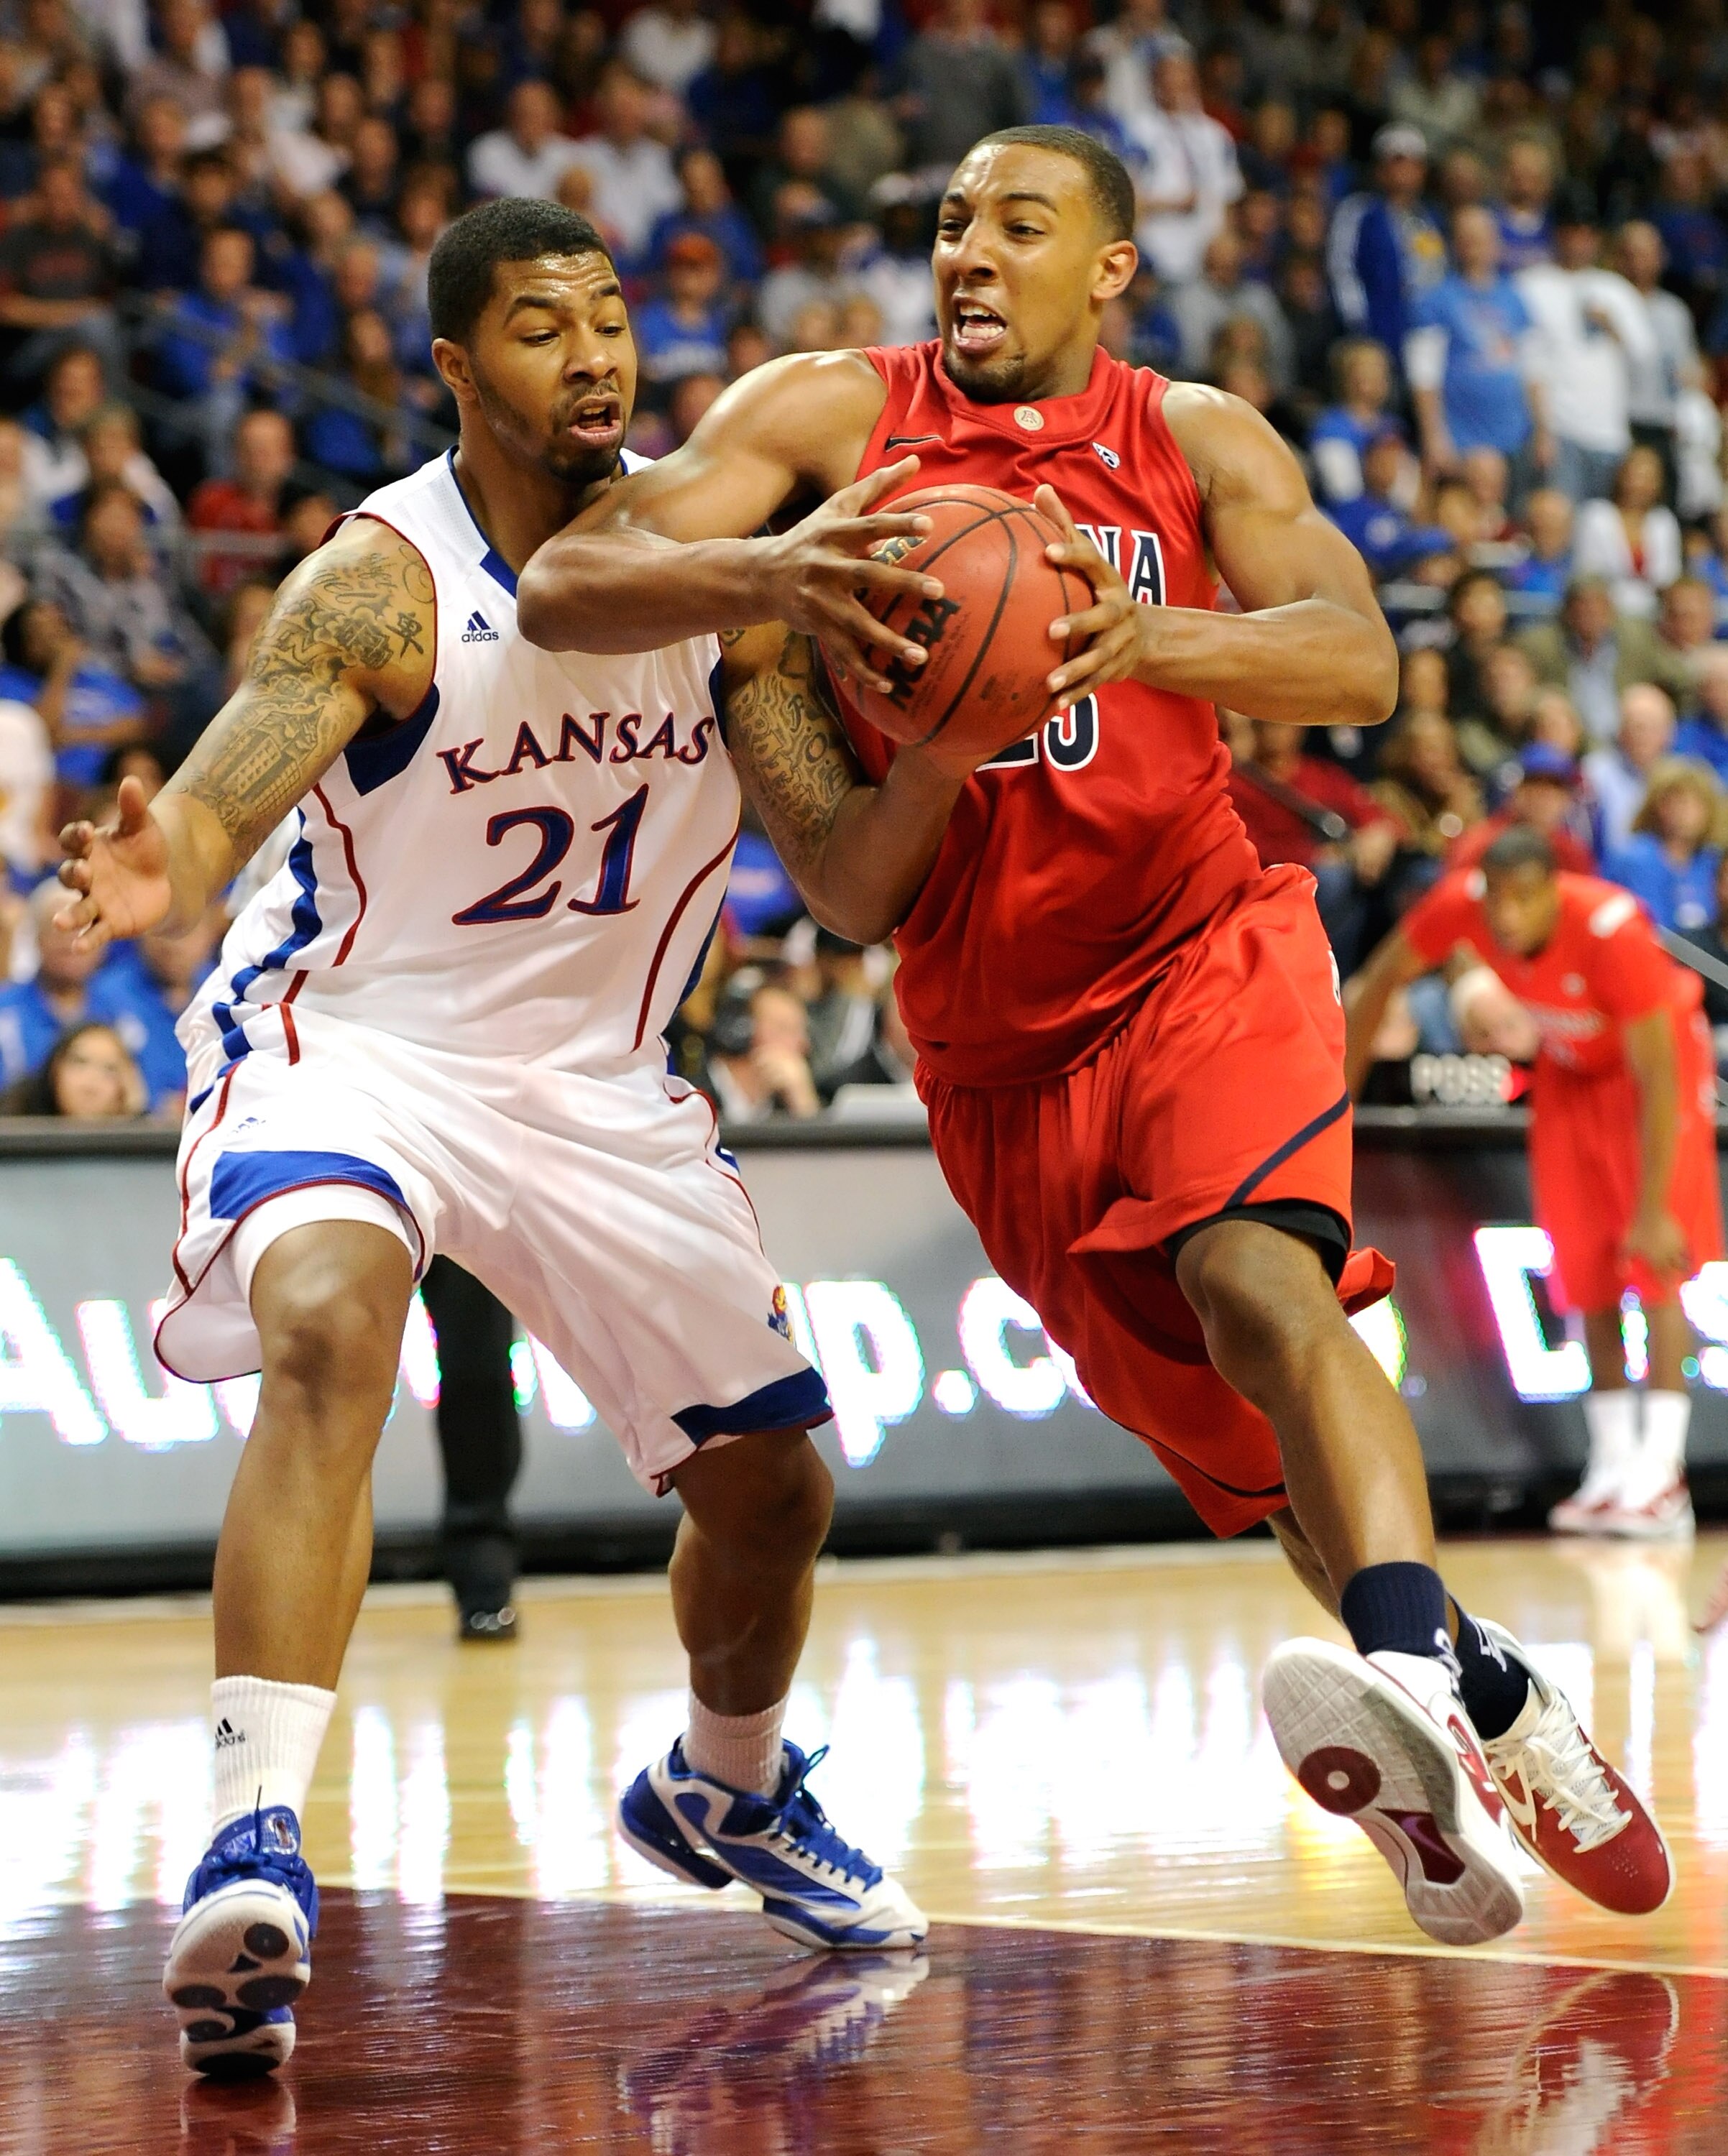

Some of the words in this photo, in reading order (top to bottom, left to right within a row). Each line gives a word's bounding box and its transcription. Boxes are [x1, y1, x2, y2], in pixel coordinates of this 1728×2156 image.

[461, 629, 499, 642] adidas
[436, 711, 714, 794] KANSAS
[452, 783, 649, 926] 21
